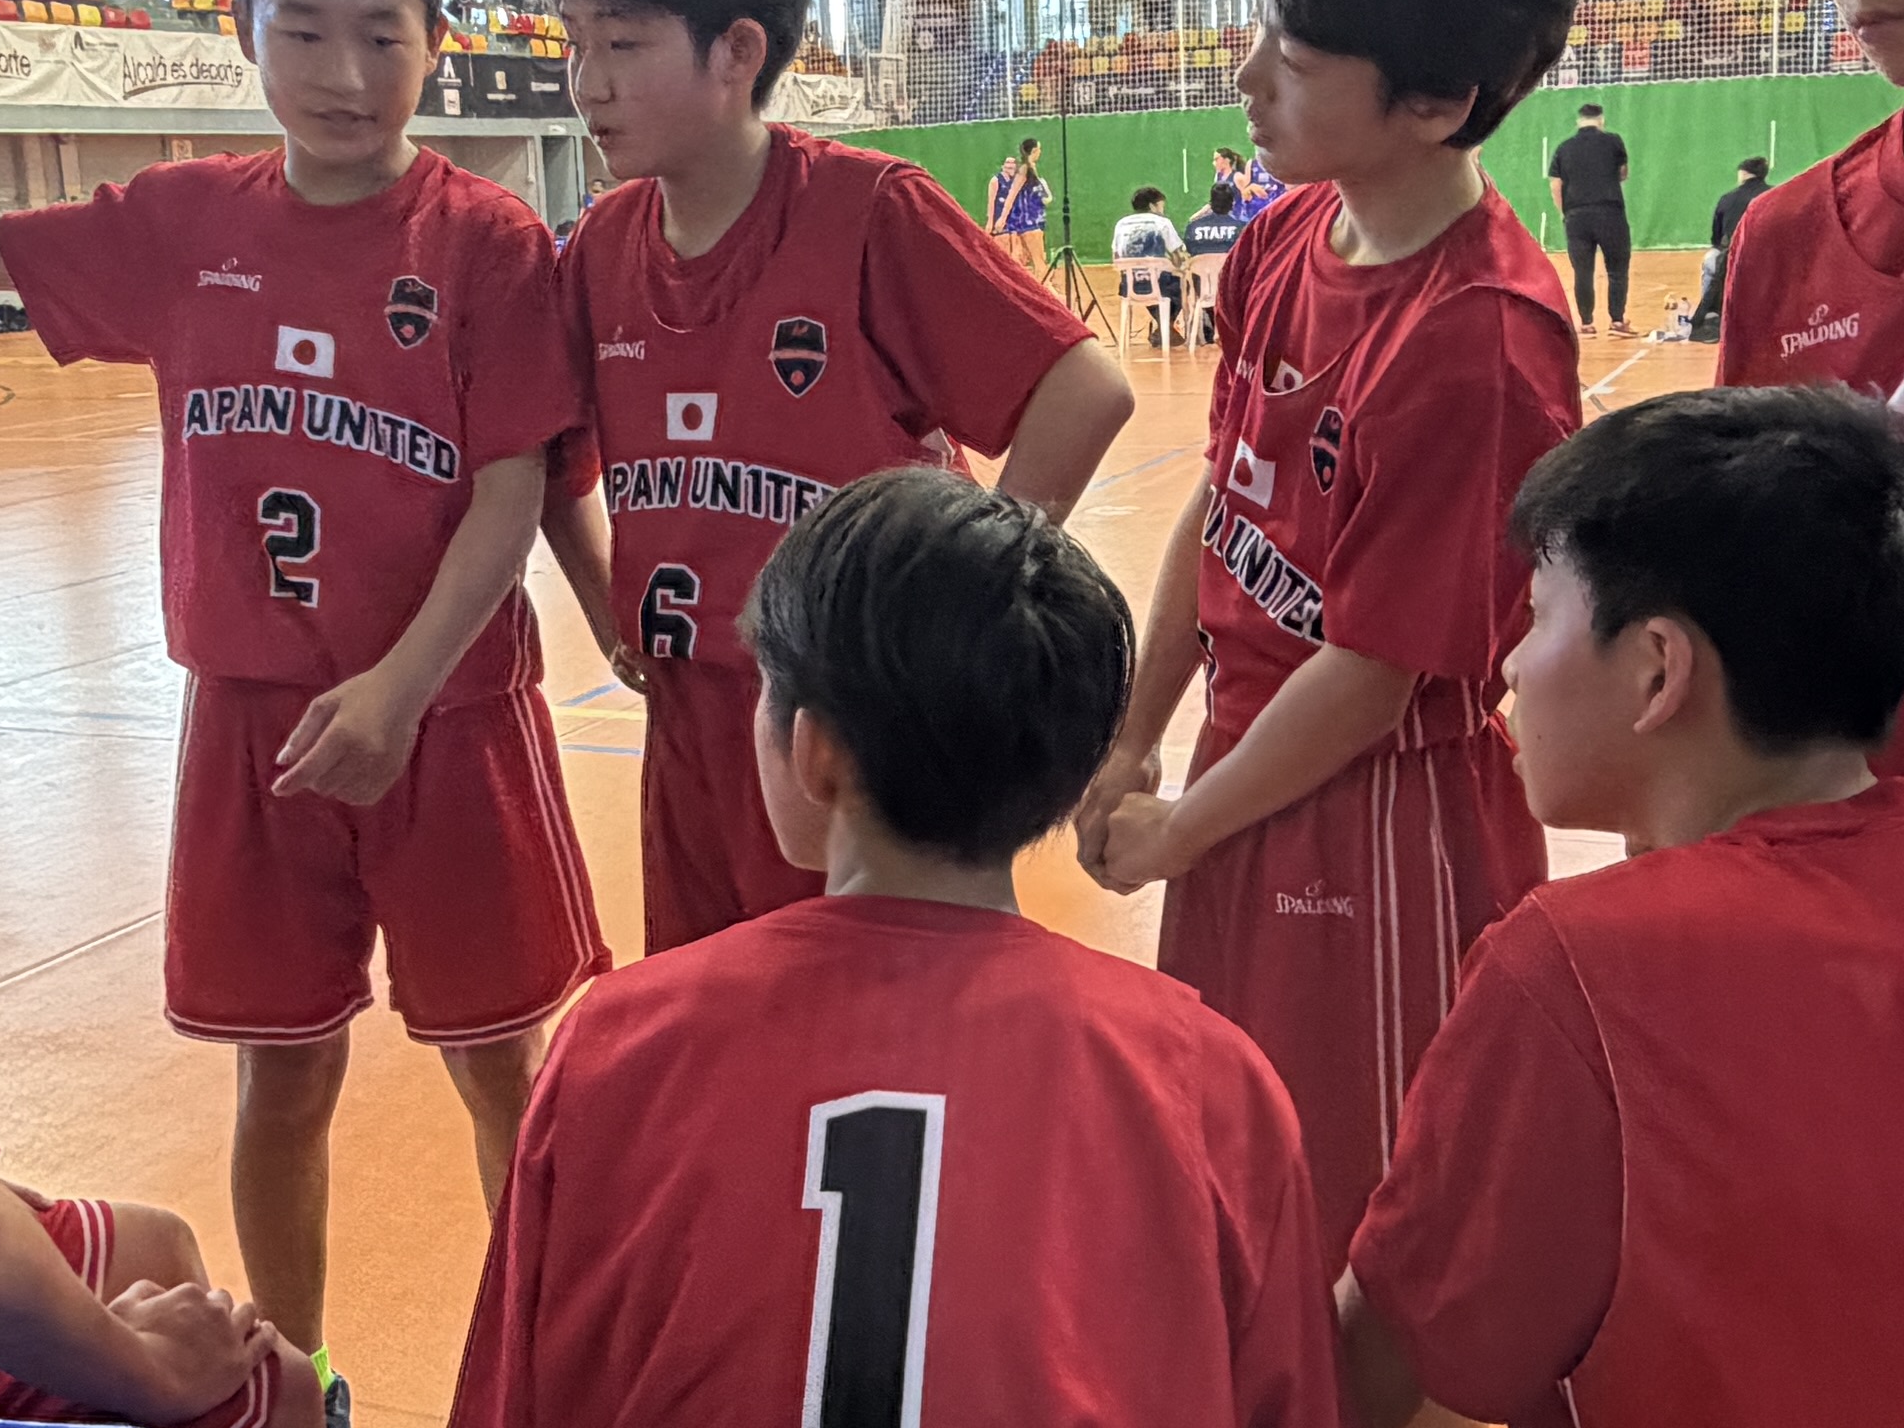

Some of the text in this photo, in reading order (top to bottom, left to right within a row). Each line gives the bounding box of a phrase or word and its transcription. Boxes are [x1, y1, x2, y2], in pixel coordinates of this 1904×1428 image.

[1194, 225, 1237, 240] STAFF
[1779, 311, 1860, 359] SPALDING
[182, 384, 295, 442] APAN
[604, 456, 687, 514] PAN
[257, 486, 322, 609] 2
[638, 563, 701, 661] 6
[1275, 892, 1354, 917] SPALDING
